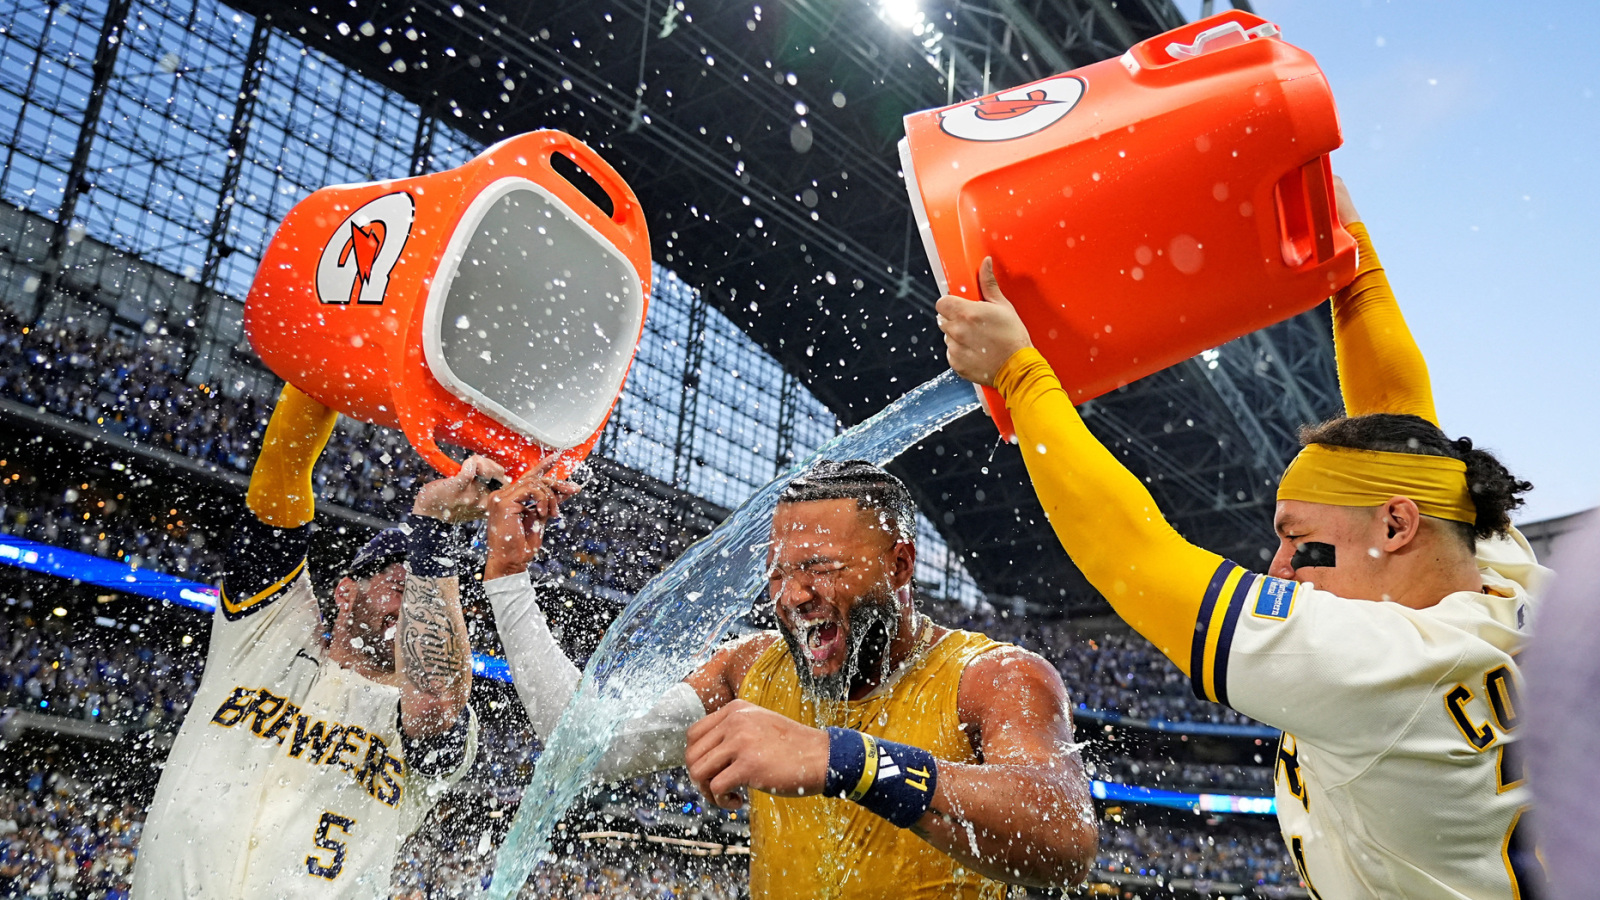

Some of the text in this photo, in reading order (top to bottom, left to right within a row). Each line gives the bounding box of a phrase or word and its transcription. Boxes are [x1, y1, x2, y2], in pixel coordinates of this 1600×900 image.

[210, 686, 404, 809] BREWERS
[1443, 661, 1525, 753] CO
[905, 765, 930, 791] 11
[305, 810, 357, 881] 5
